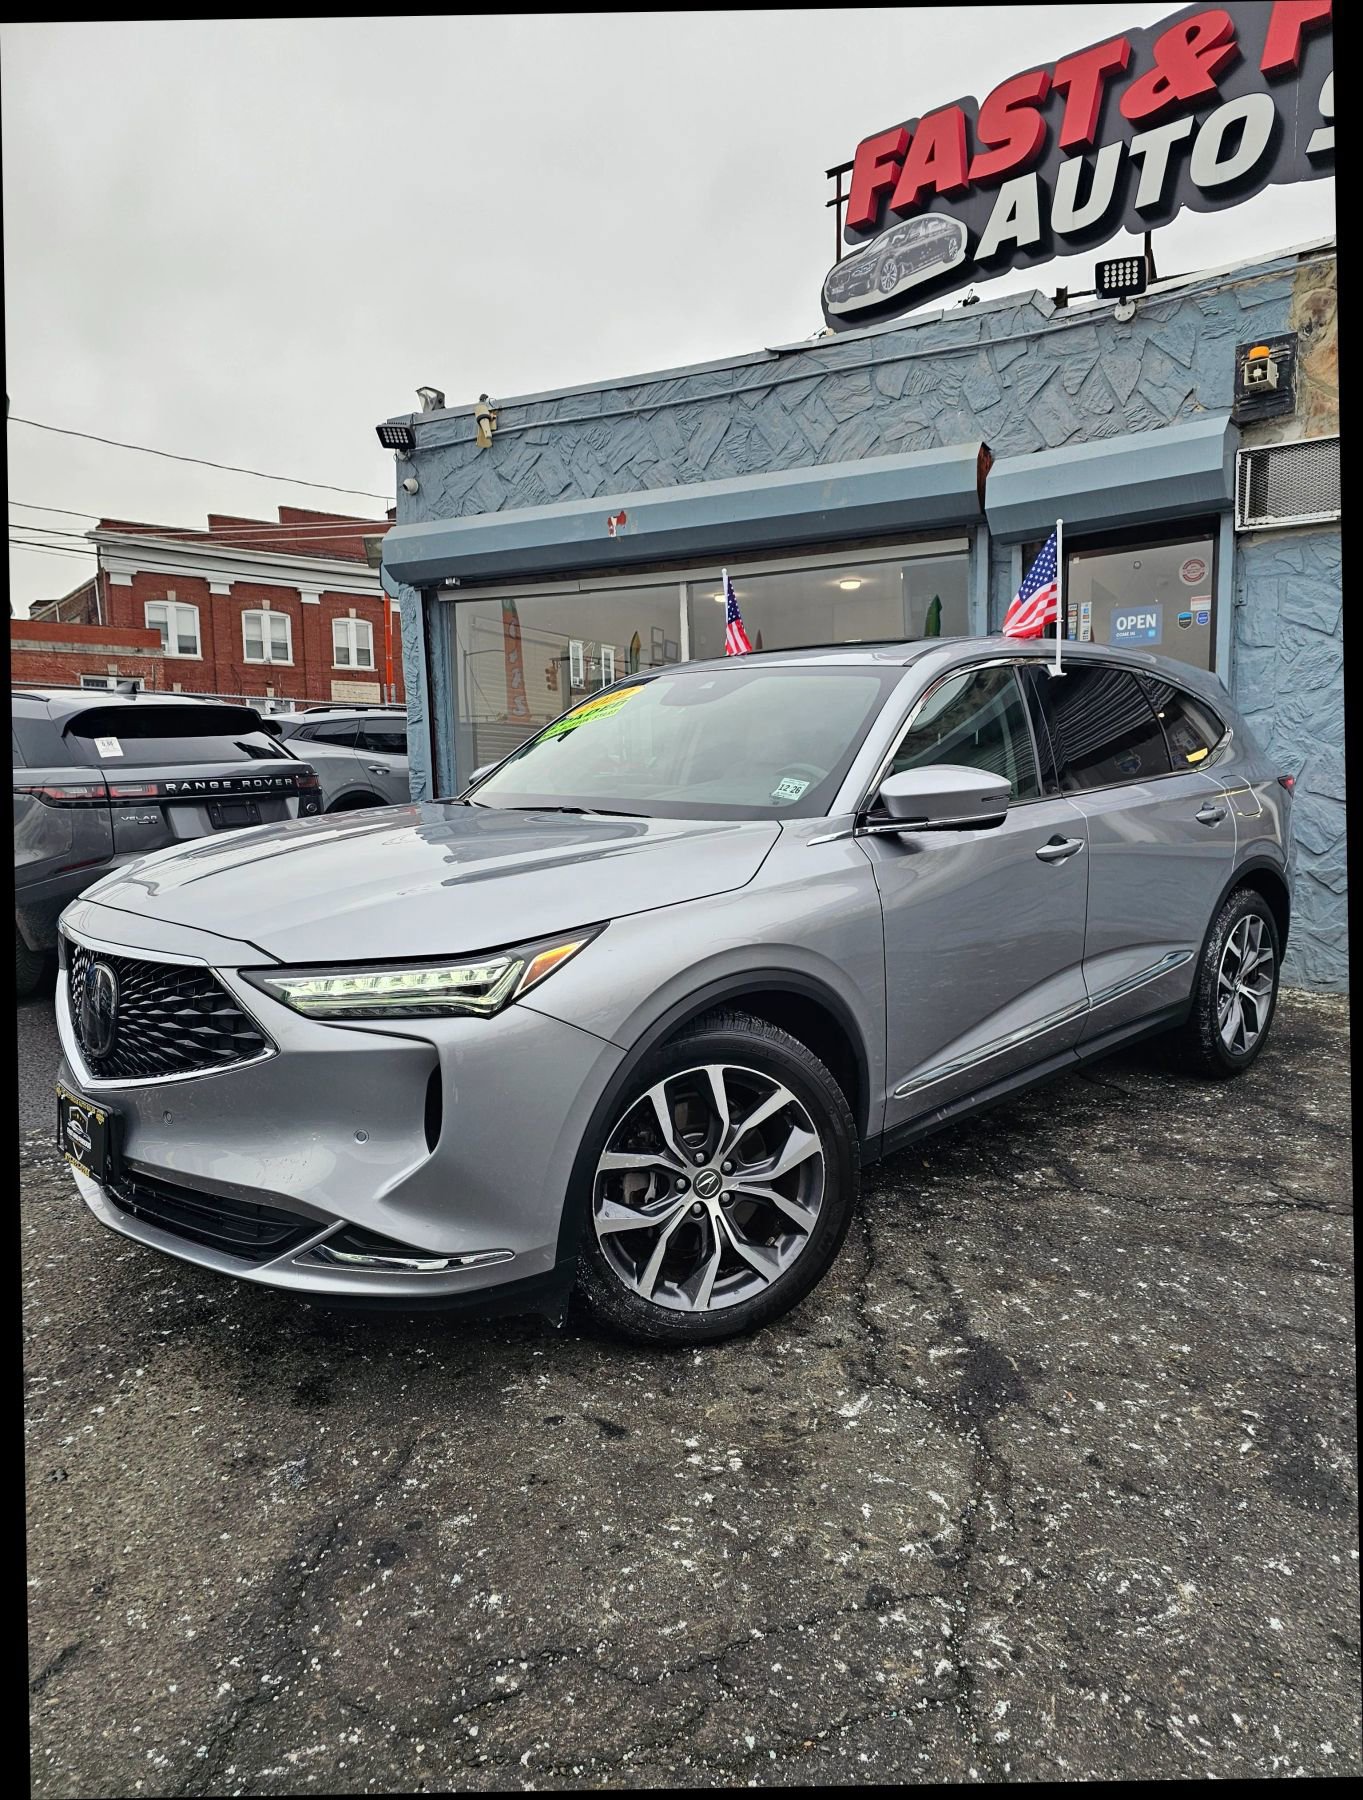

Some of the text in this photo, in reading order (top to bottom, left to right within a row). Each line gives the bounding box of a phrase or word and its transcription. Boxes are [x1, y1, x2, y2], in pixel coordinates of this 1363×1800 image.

[845, 36, 1131, 228] FAST
[1119, 9, 1237, 120] &
[973, 92, 1275, 262] AUTO
[1116, 613, 1157, 631] OPEN
[165, 778, 293, 791] RANGE ROVER
